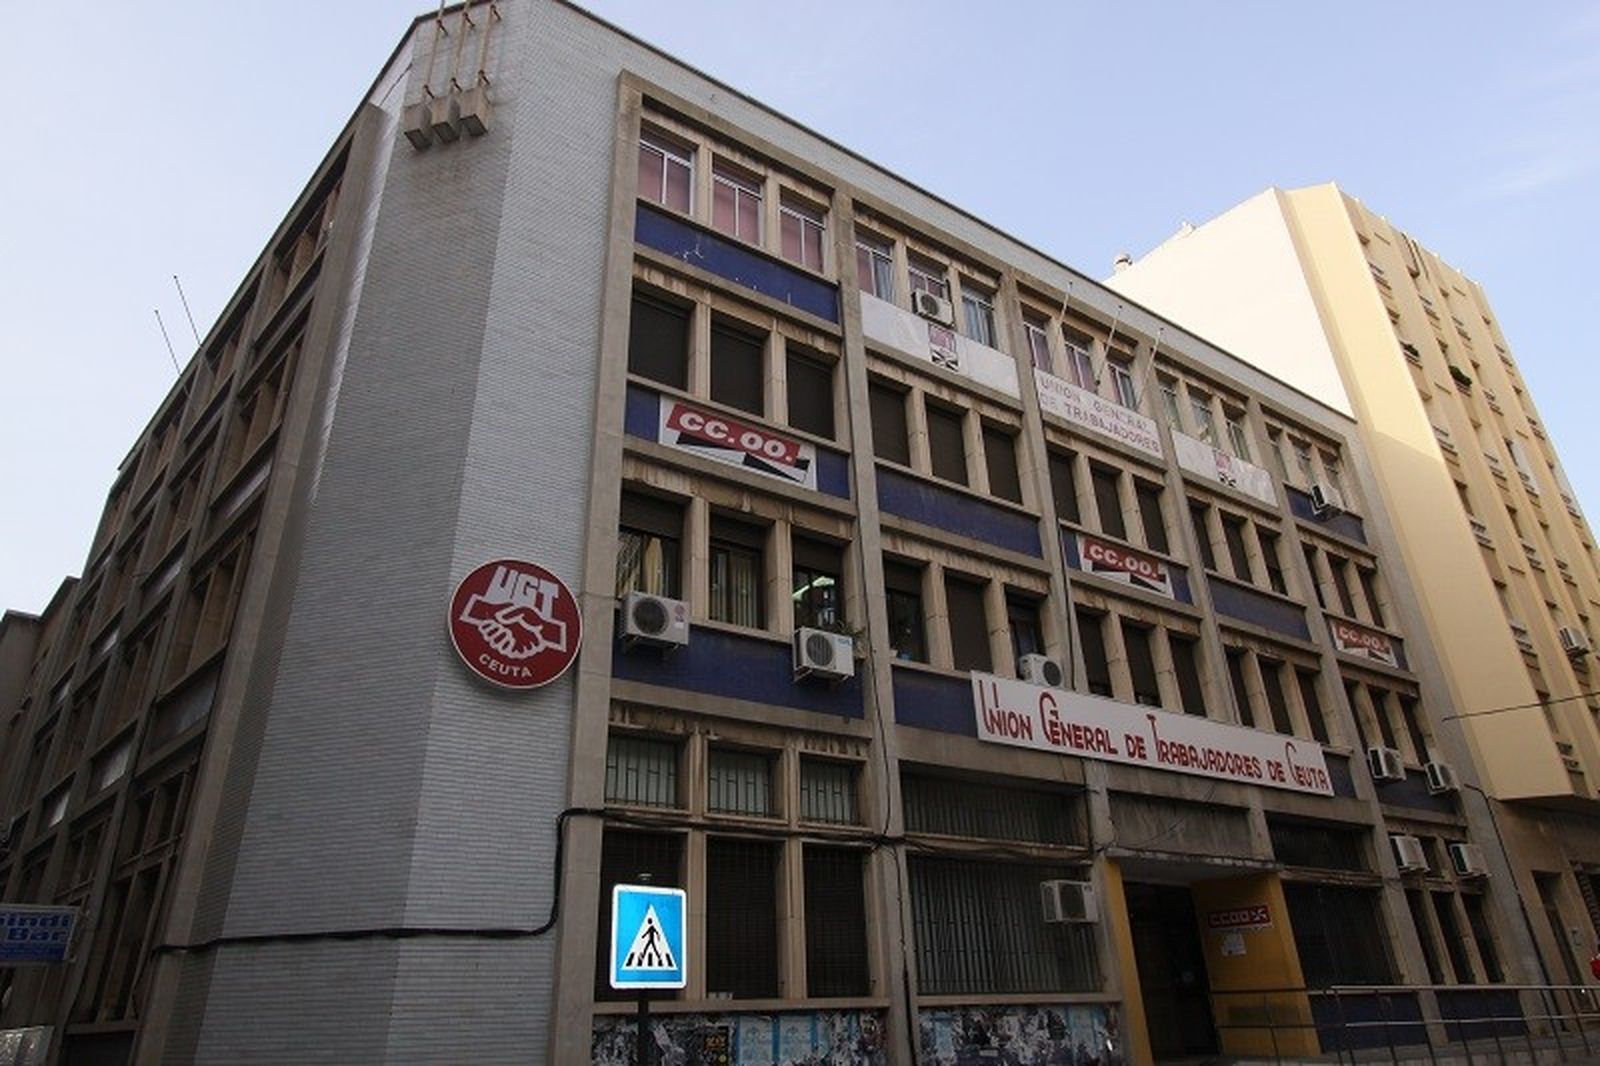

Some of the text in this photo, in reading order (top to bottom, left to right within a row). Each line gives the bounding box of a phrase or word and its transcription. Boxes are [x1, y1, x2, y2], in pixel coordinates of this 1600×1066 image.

[678, 411, 794, 463] CC.OO.
[1063, 402, 1161, 453] TRABAJADORES
[484, 564, 560, 620] UGT
[478, 652, 533, 679] CEUTA
[1124, 733, 1148, 761] DE
[1266, 759, 1287, 783] DE
[7, 928, 68, 943] Bar
